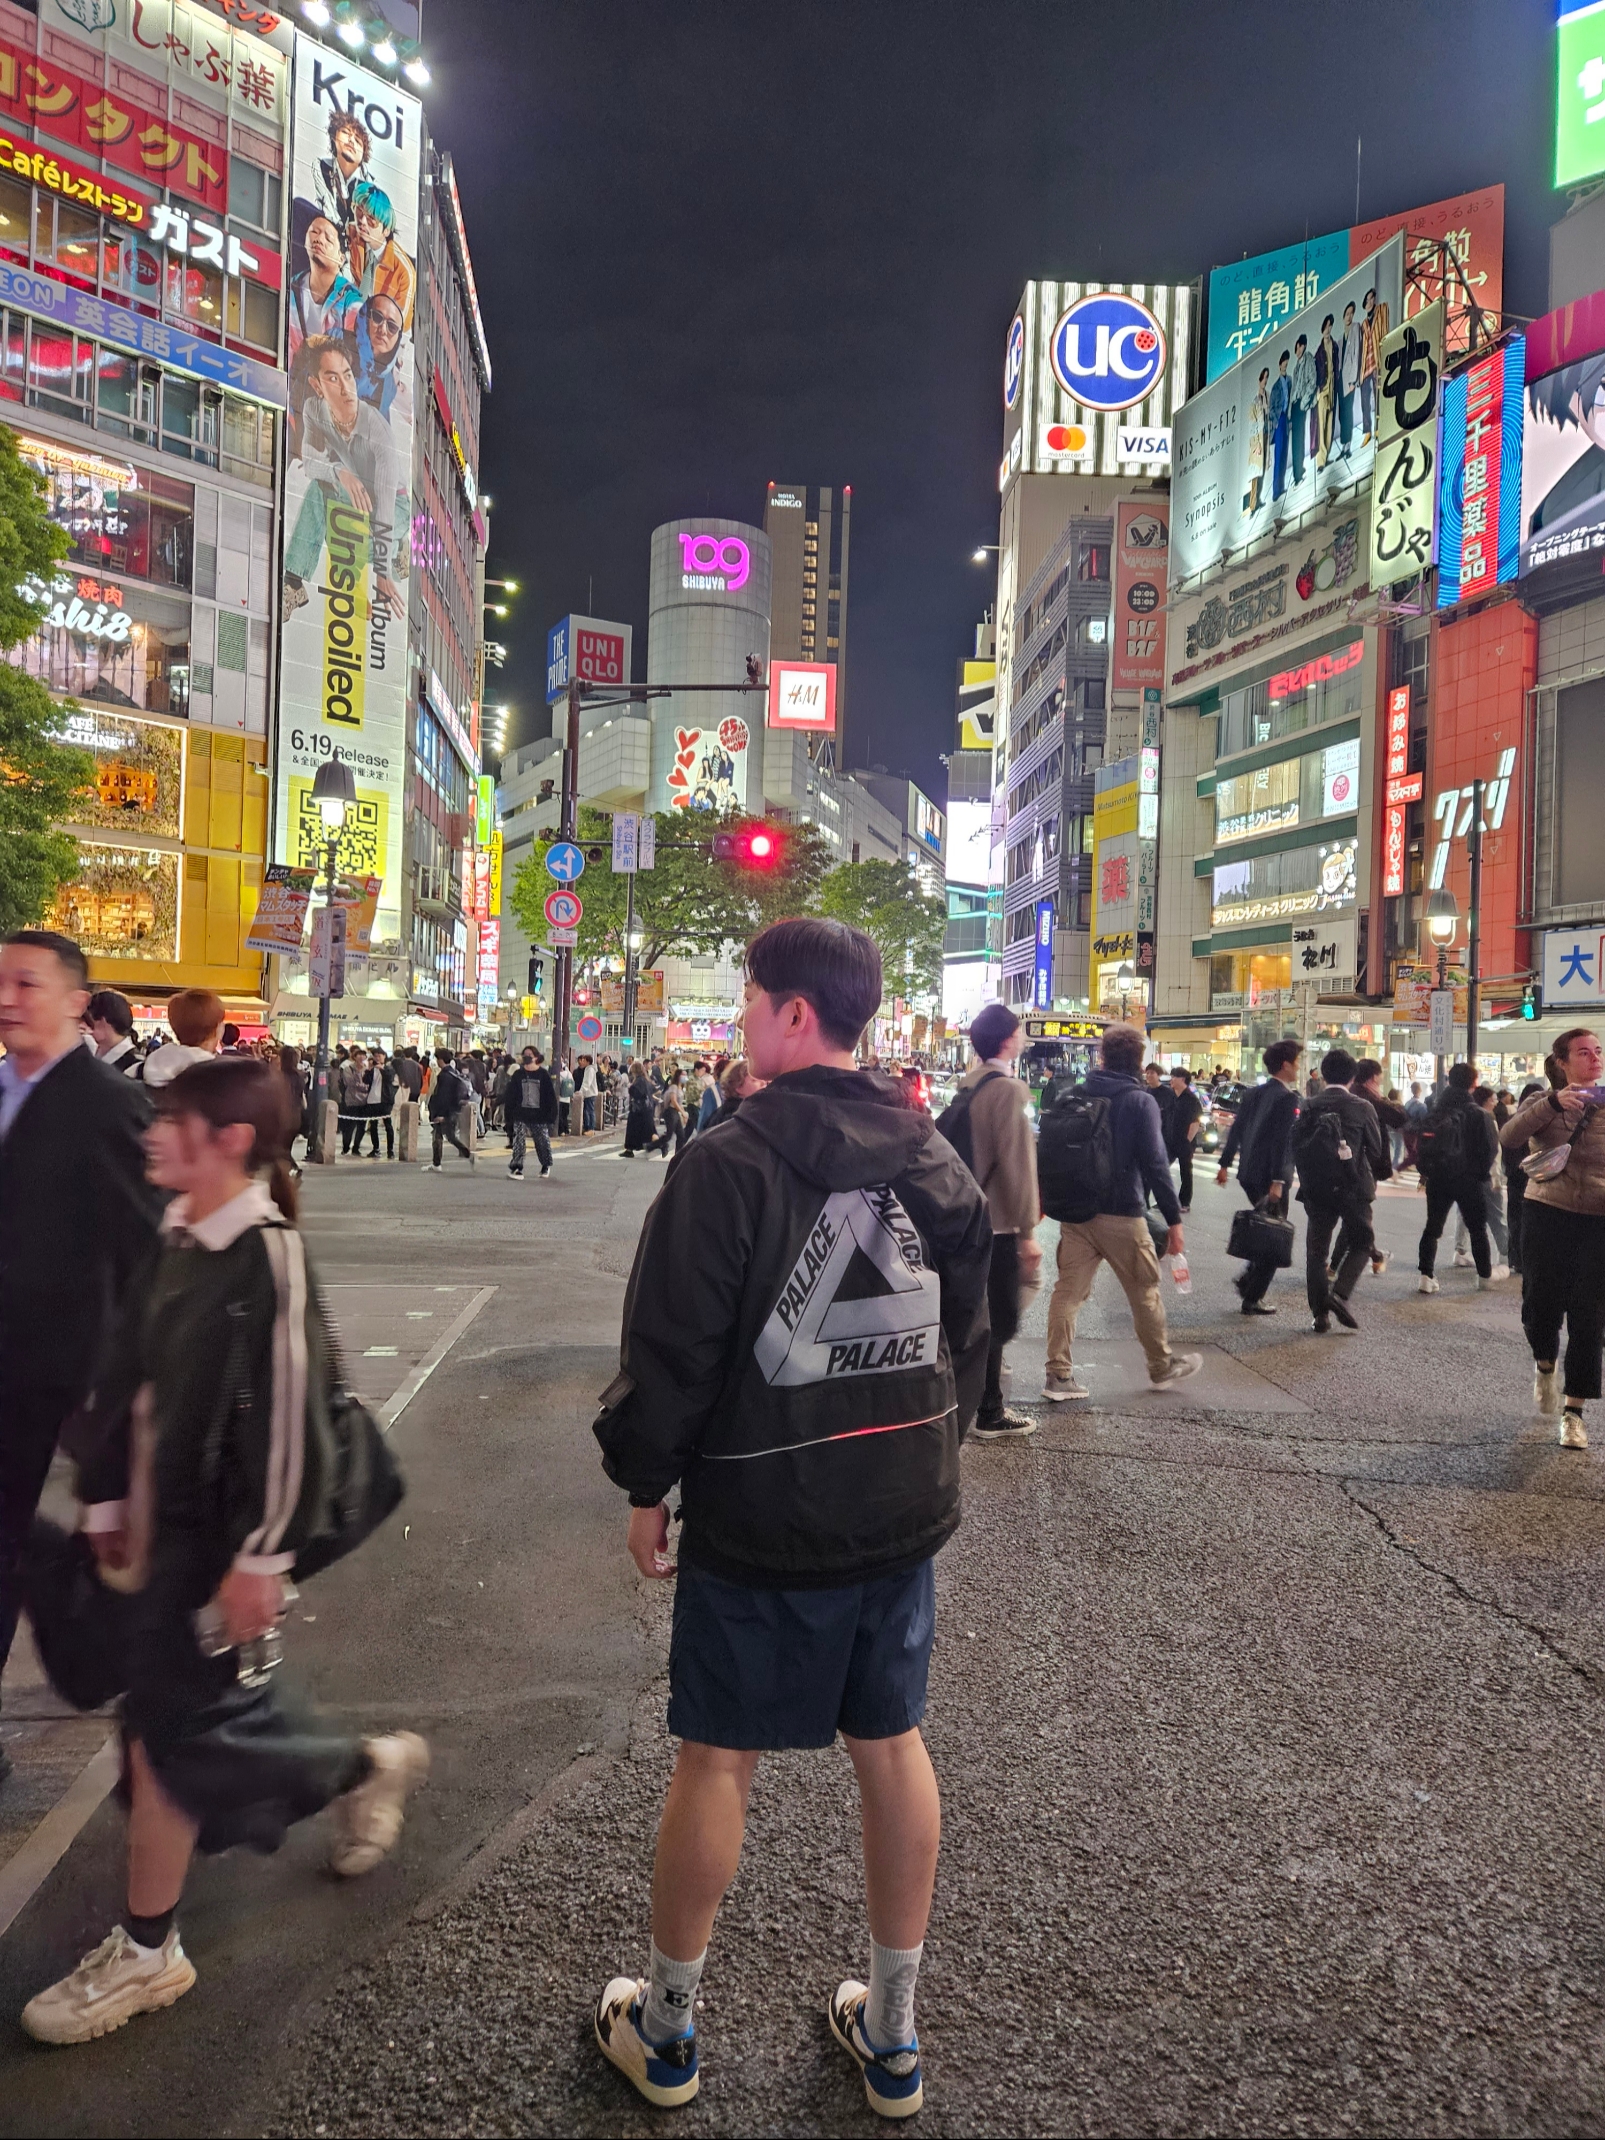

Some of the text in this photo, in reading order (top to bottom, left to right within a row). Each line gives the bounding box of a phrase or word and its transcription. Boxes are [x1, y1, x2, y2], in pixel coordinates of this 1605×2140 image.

[312, 57, 404, 151] Kroi
[150, 203, 260, 277] ガスト
[1120, 434, 1169, 454] VISA
[1377, 326, 1437, 565] もんじゃ
[1458, 364, 1493, 585] 三千里薬品
[770, 498, 803, 509] INDIGO
[1185, 491, 1226, 528] Synopsis
[678, 532, 750, 592] 109
[77, 577, 124, 609] 焼肉
[370, 518, 394, 671] New Album
[682, 574, 725, 592] SHIBUYA
[42, 591, 133, 642] shi8
[317, 507, 364, 726] Unspoiled
[1128, 619, 1157, 638] B1F
[553, 629, 565, 662] THE
[582, 636, 616, 659] UNI
[1126, 639, 1158, 658] B2F
[547, 655, 568, 694] PRIME
[581, 657, 618, 679] QLO
[787, 684, 820, 706] H&M
[291, 729, 390, 768] 6.19 Release
[1391, 692, 1407, 774] お好み焼
[1097, 796, 1128, 812] Matsumoto
[623, 818, 635, 868] 渋谷駅前
[1386, 810, 1402, 892] もんじゃ焼
[263, 886, 292, 900] 渋谷
[476, 880, 487, 907] アコム
[1102, 854, 1131, 905] 薬
[1041, 910, 1051, 946] MIZUHO
[1558, 944, 1594, 988] 大
[277, 1011, 312, 1019] SHIBUYA
[1434, 996, 1445, 1045] 文化村通り
[865, 1184, 924, 1275] PALACE
[775, 1211, 836, 1333] PALACE
[826, 1333, 927, 1376] PALACE
